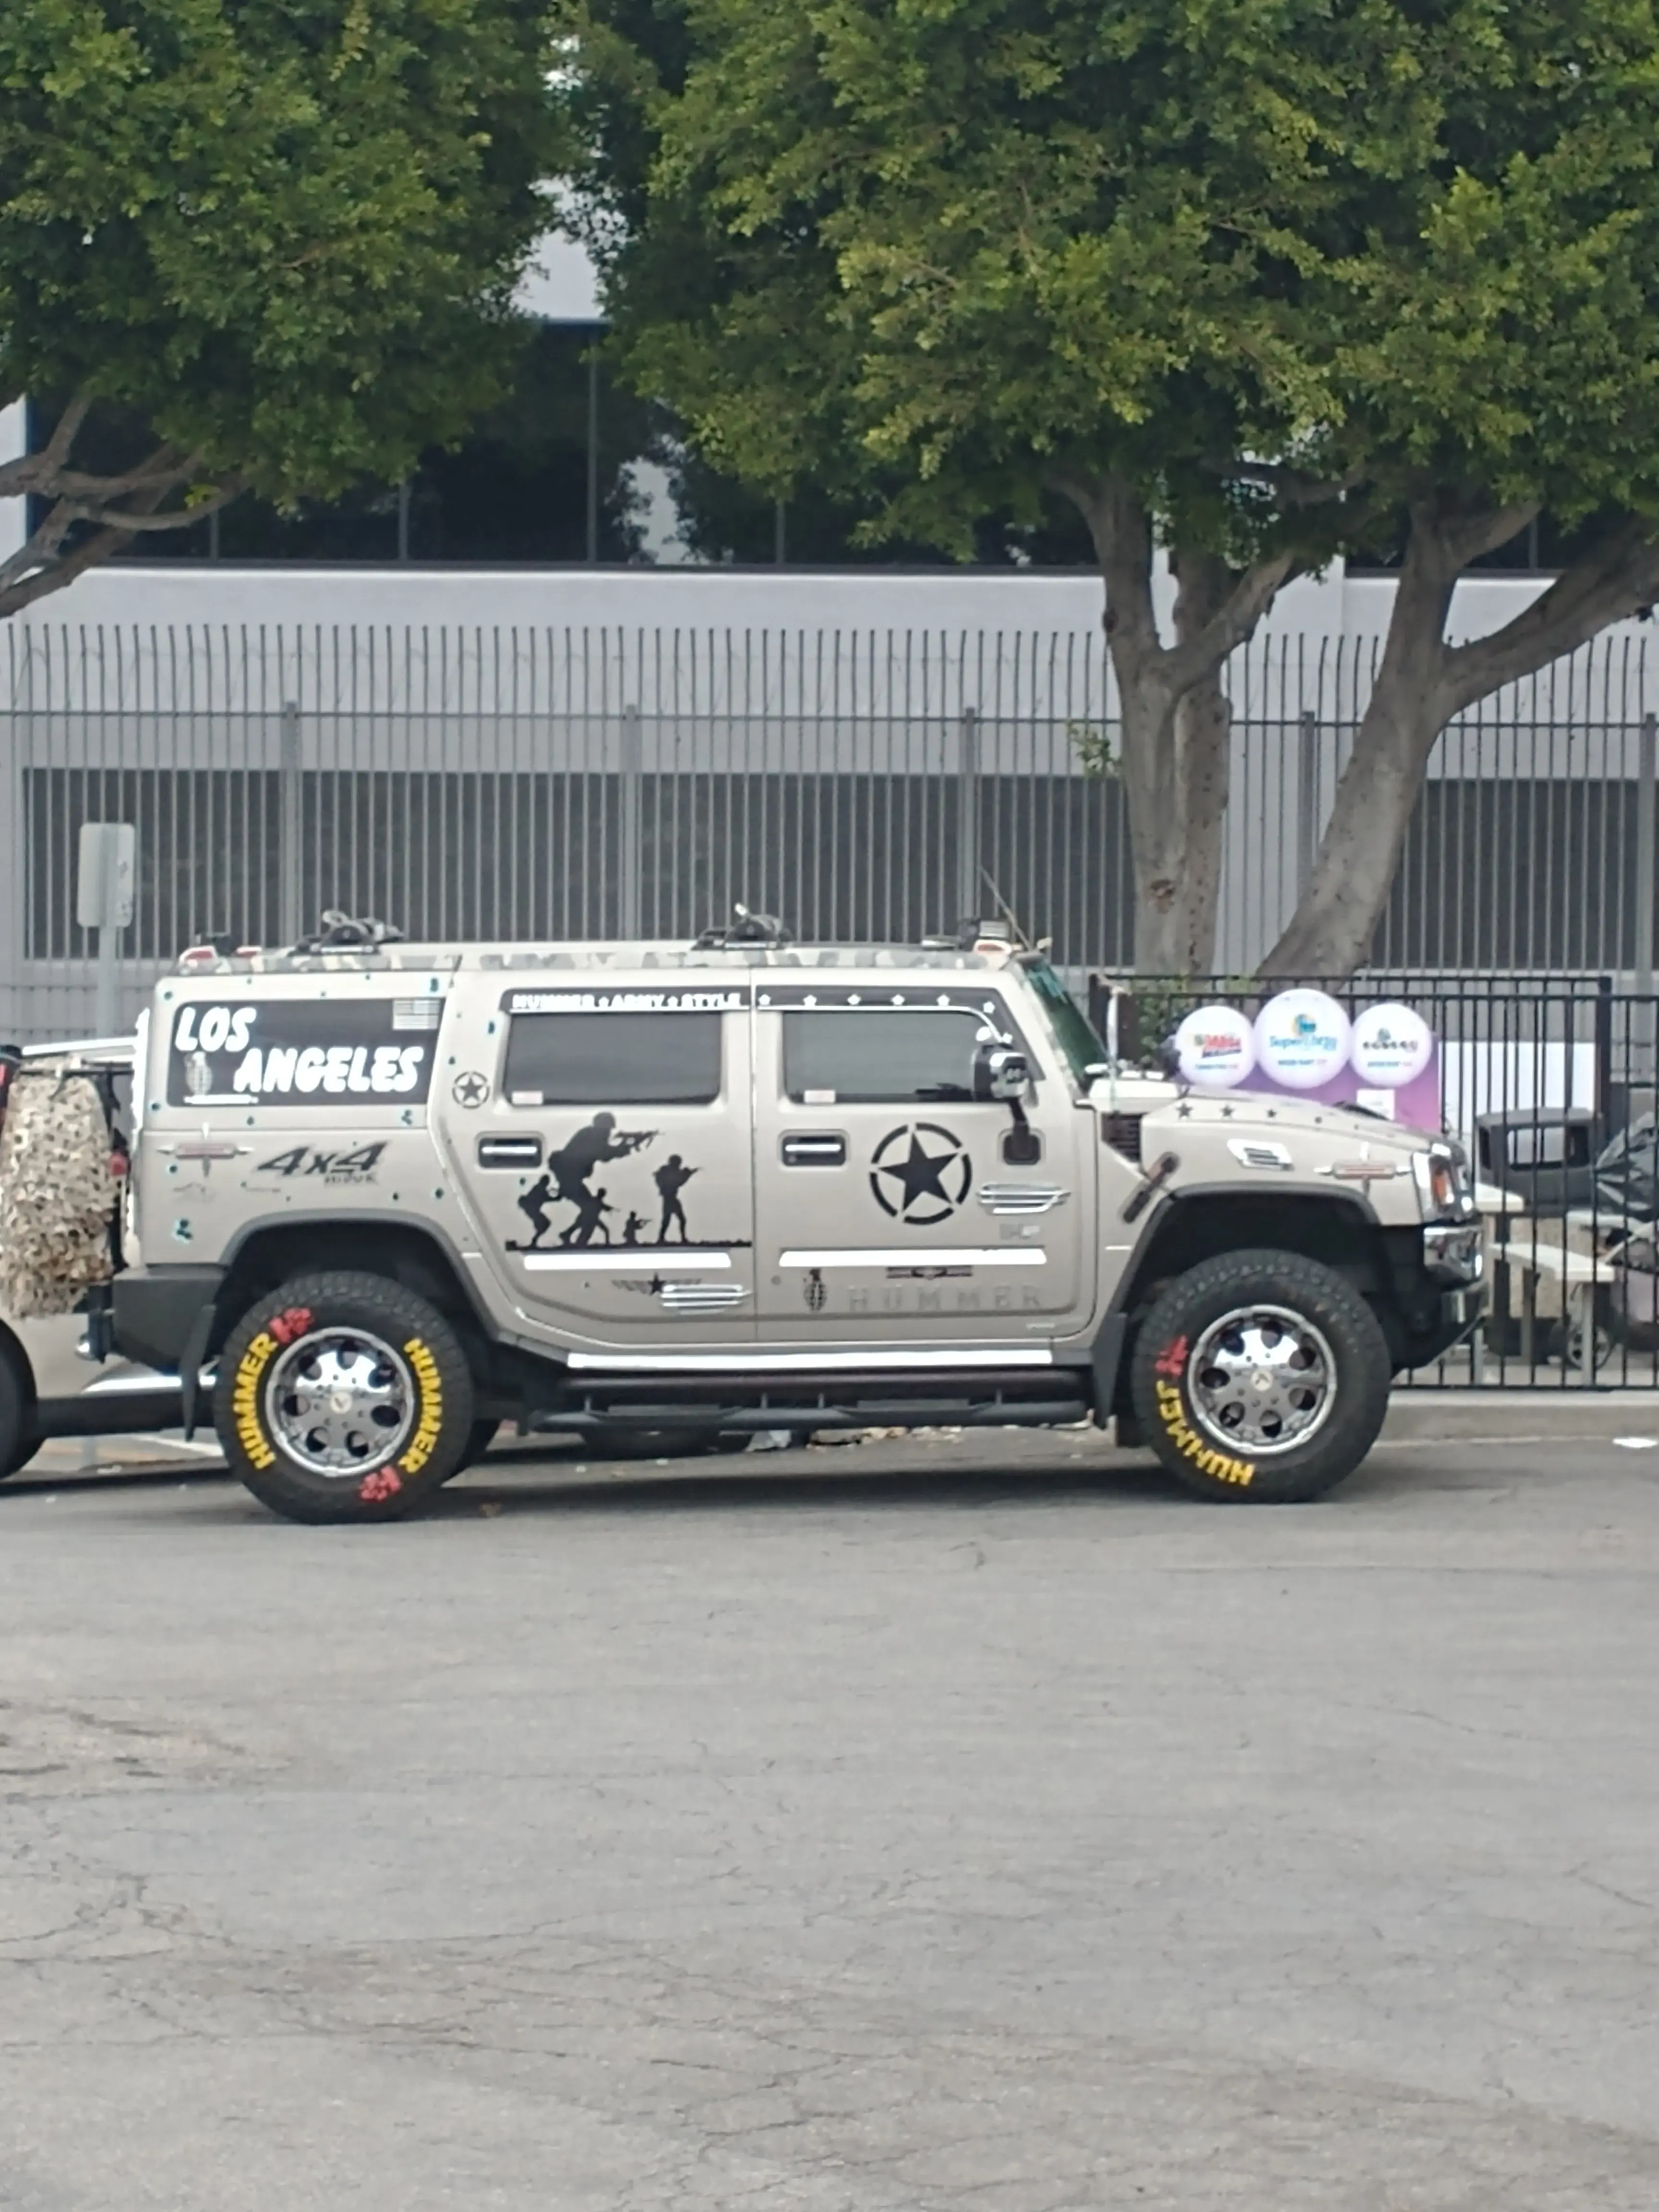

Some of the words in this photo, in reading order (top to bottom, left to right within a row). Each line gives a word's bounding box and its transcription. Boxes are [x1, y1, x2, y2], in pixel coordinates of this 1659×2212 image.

[682, 993, 741, 1007] STYLE
[175, 1007, 257, 1052] LOS
[233, 1046, 425, 1093] ANGELES
[847, 1284, 1042, 1312] HUMMER
[233, 1333, 279, 1470] HUMMER
[397, 1337, 443, 1473] HUMMER
[1156, 1380, 1255, 1486] HUMMER
